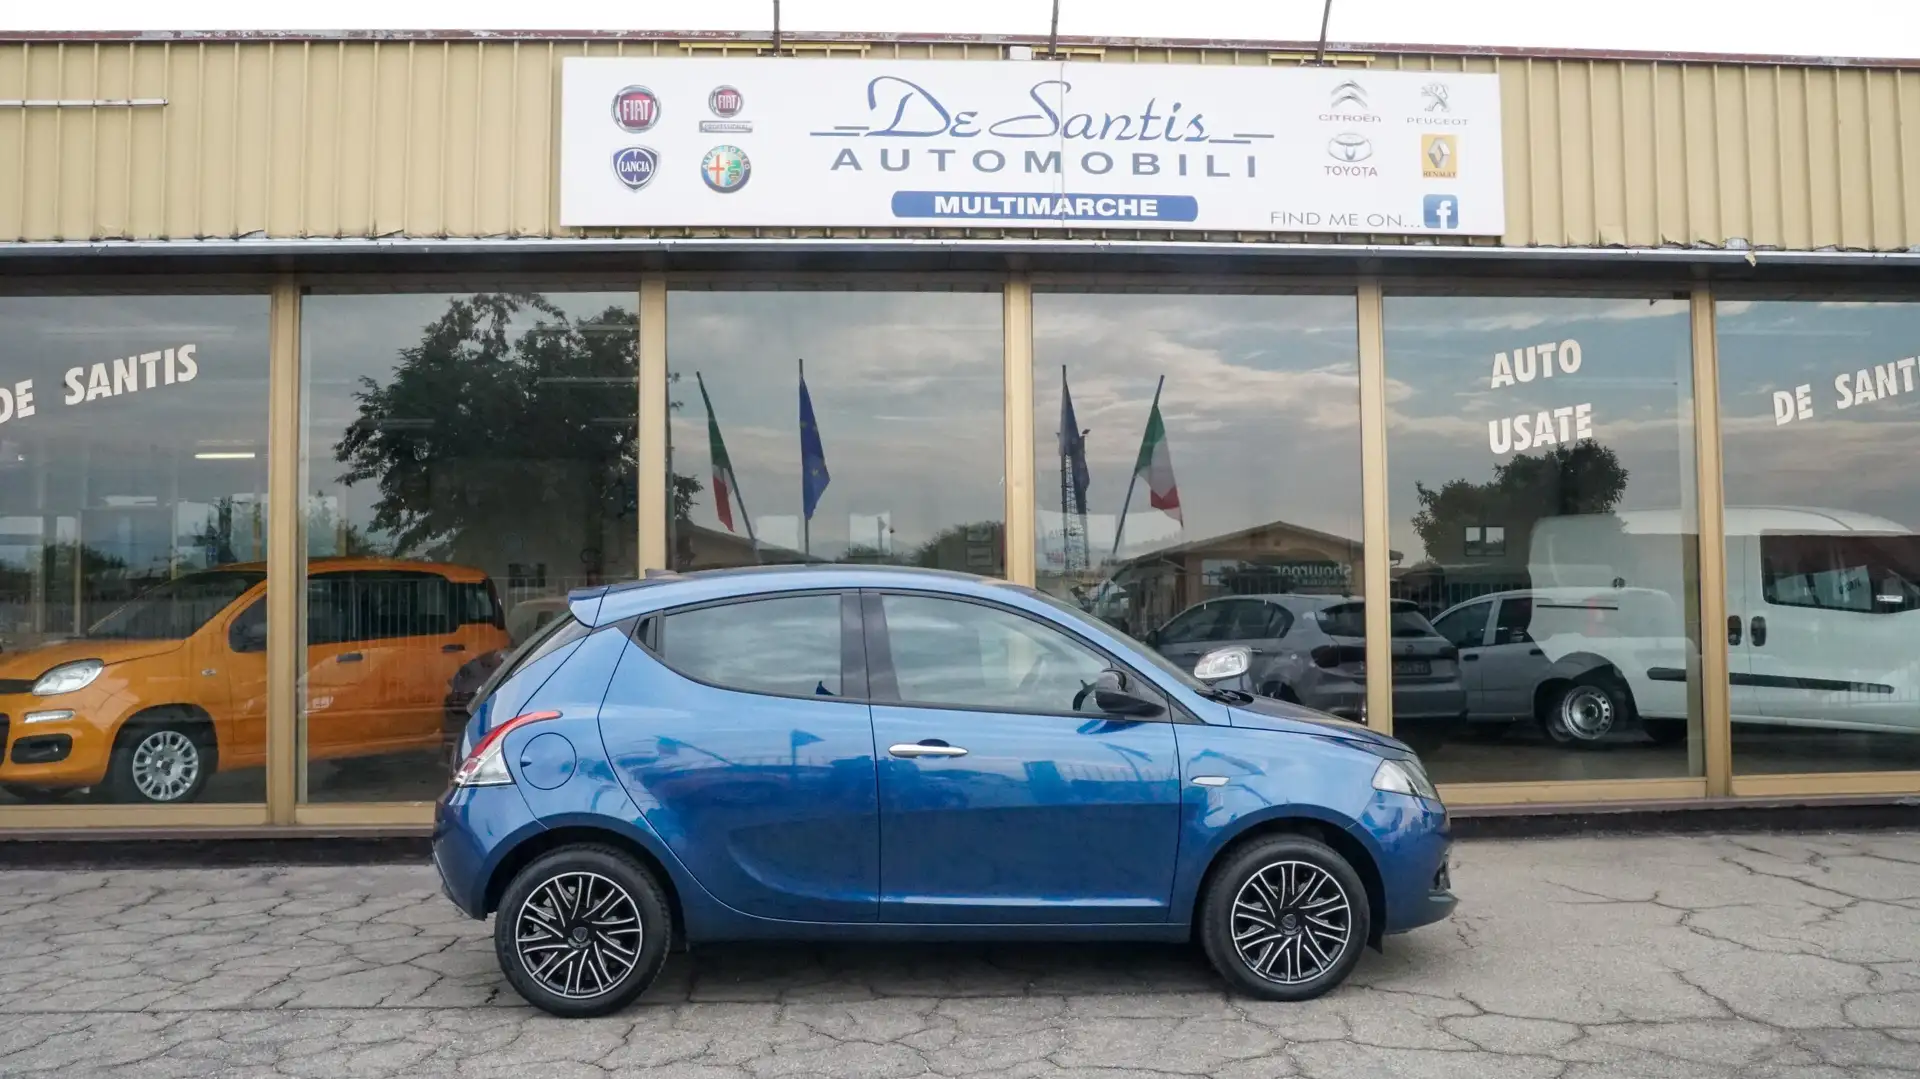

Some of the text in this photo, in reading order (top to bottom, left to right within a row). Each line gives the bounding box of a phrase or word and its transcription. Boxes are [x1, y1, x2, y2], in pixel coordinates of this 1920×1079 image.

[622, 99, 651, 121] FIAT
[717, 94, 738, 109] FIAT
[988, 80, 1211, 142] Santis
[1406, 117, 1470, 126] PEUGEOT
[621, 160, 650, 173] LANCIA
[830, 148, 1256, 178] AUTOMOBILI
[1324, 165, 1378, 178] TOYOTA
[934, 195, 1159, 217] MULTIMARCHE
[1270, 210, 1321, 227] FIND
[1328, 213, 1359, 227] ME
[64, 344, 198, 406] SANTIS
[1491, 339, 1582, 389] AUTO
[1773, 383, 1813, 426] DE
[1488, 402, 1593, 454] USATE
